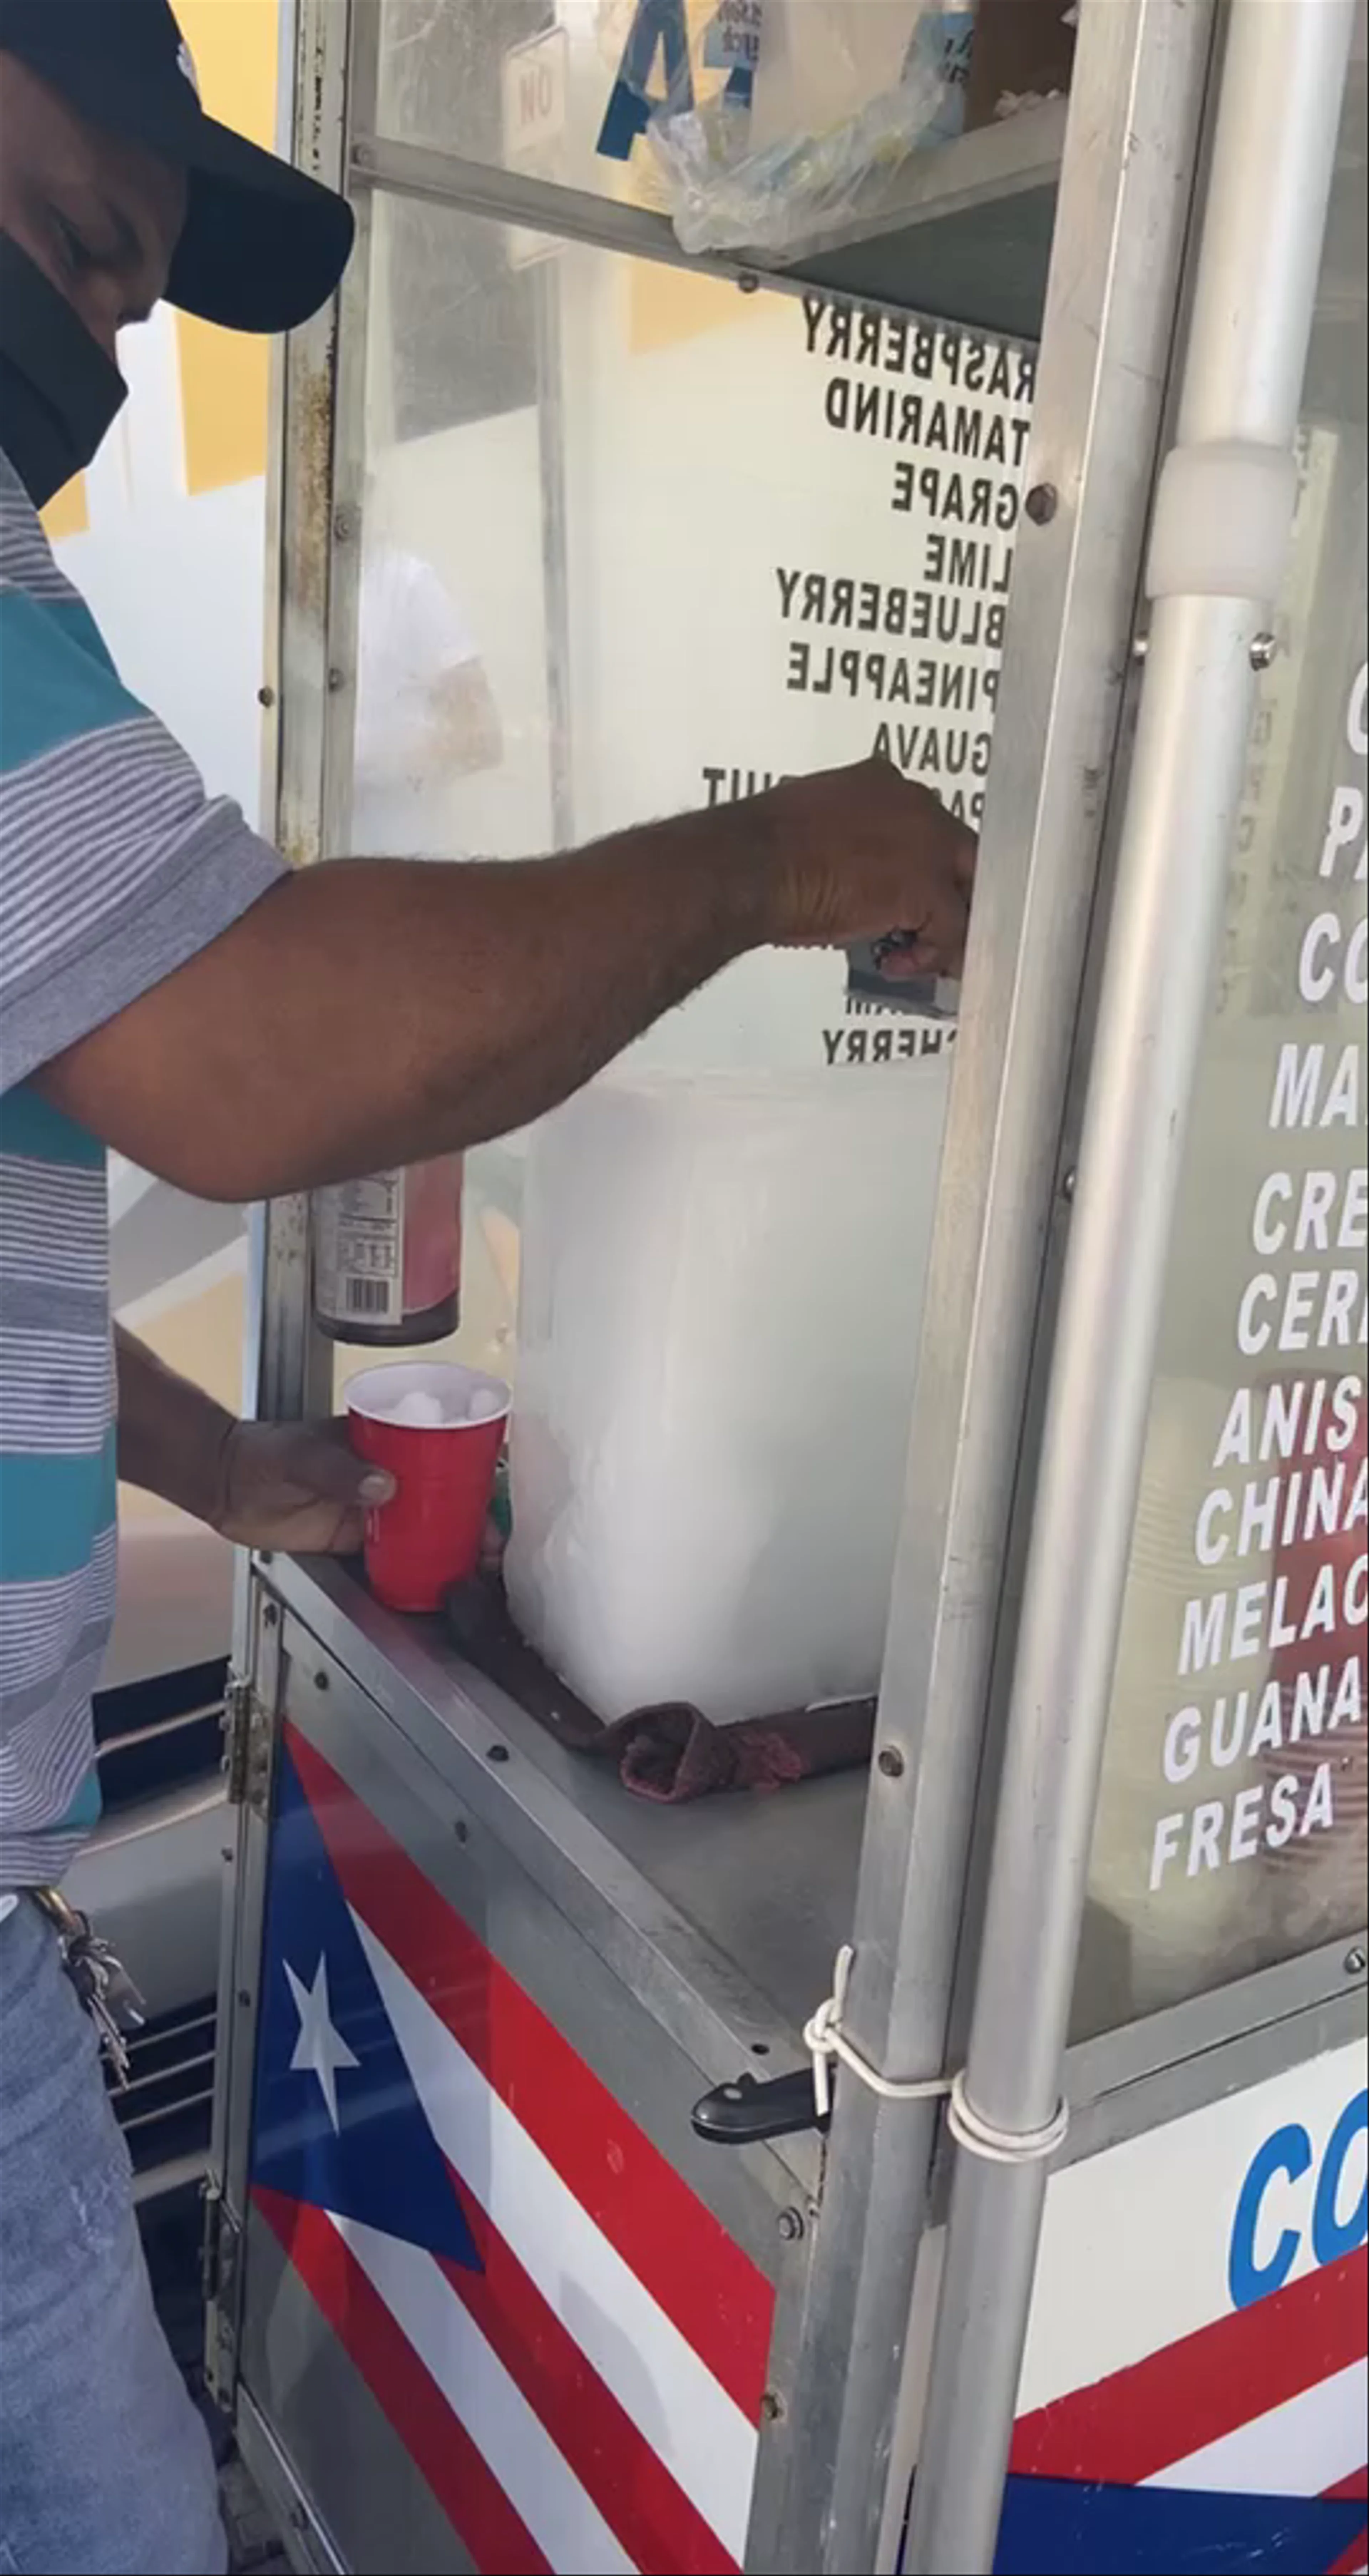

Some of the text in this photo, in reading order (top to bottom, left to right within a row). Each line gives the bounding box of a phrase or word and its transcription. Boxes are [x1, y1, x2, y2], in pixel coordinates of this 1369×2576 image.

[1268, 1043, 1368, 1129] MA
[1252, 1169, 1368, 1255] CRE
[1237, 1269, 1368, 1356] CER
[1213, 1375, 1362, 1468] ANIS
[1163, 1655, 1361, 1783] GUANA
[1149, 1763, 1333, 1892] FRESA
